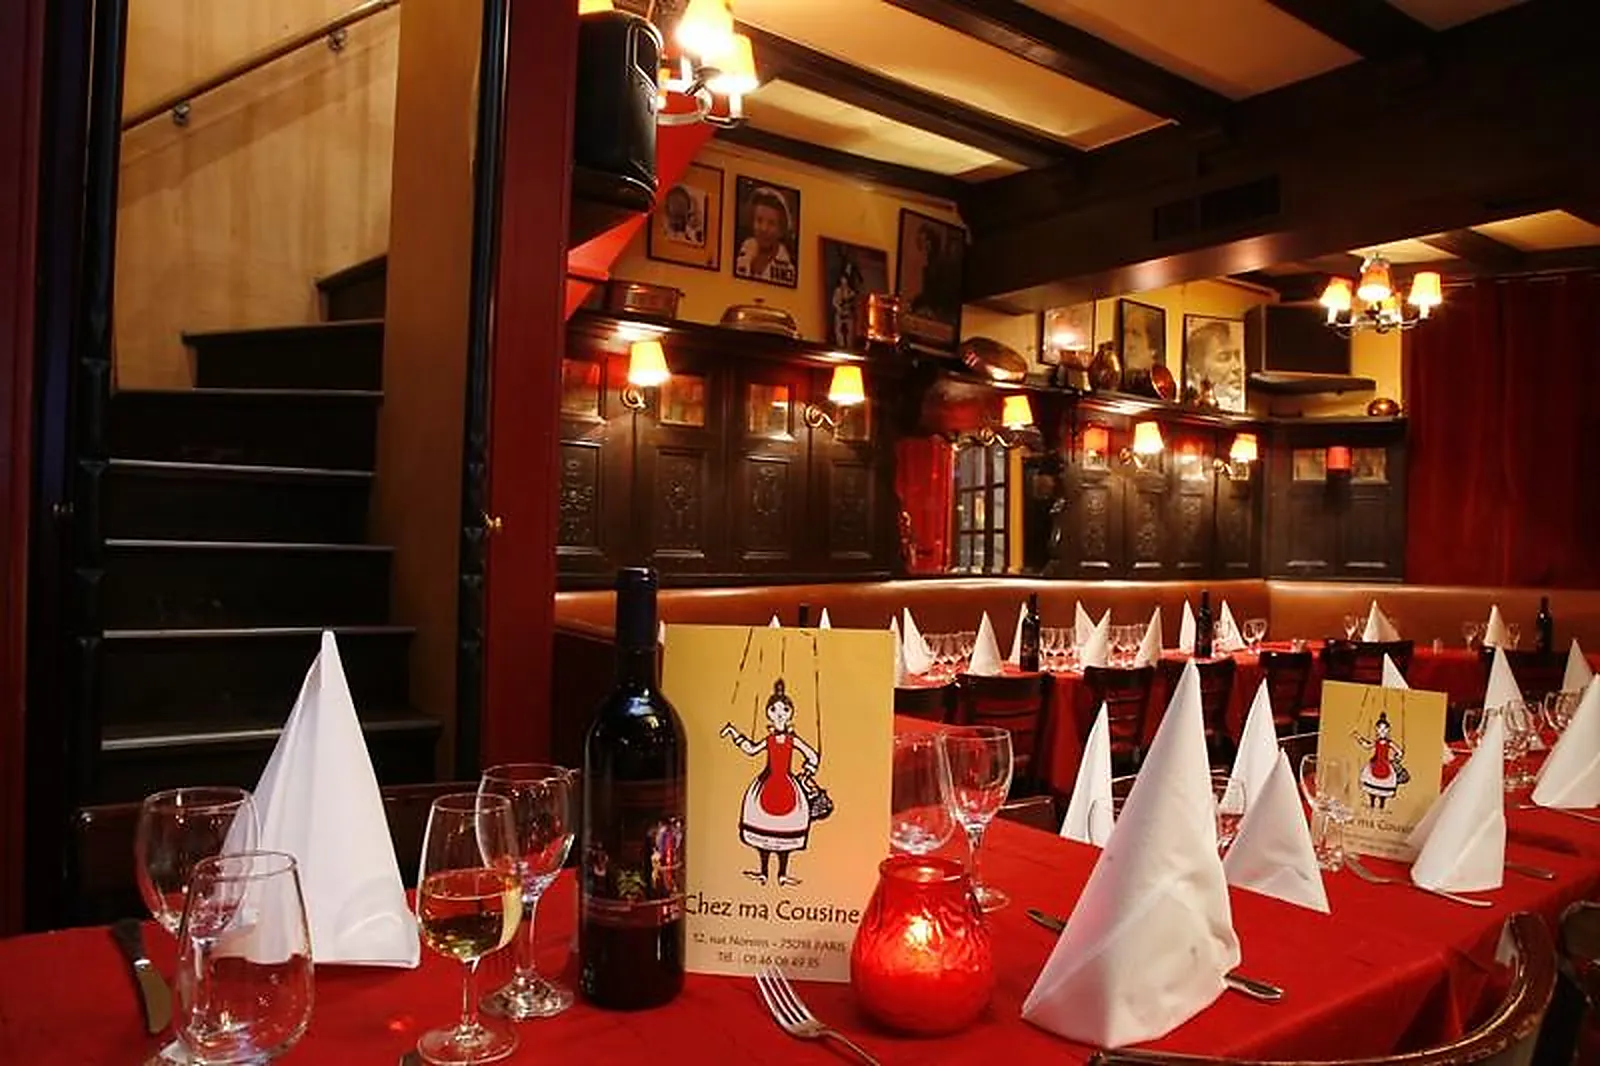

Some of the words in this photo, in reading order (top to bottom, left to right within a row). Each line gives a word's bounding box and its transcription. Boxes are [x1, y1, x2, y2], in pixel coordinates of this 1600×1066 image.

[683, 891, 732, 917] Chez
[738, 901, 769, 920] ma
[775, 899, 860, 924] Cousine
